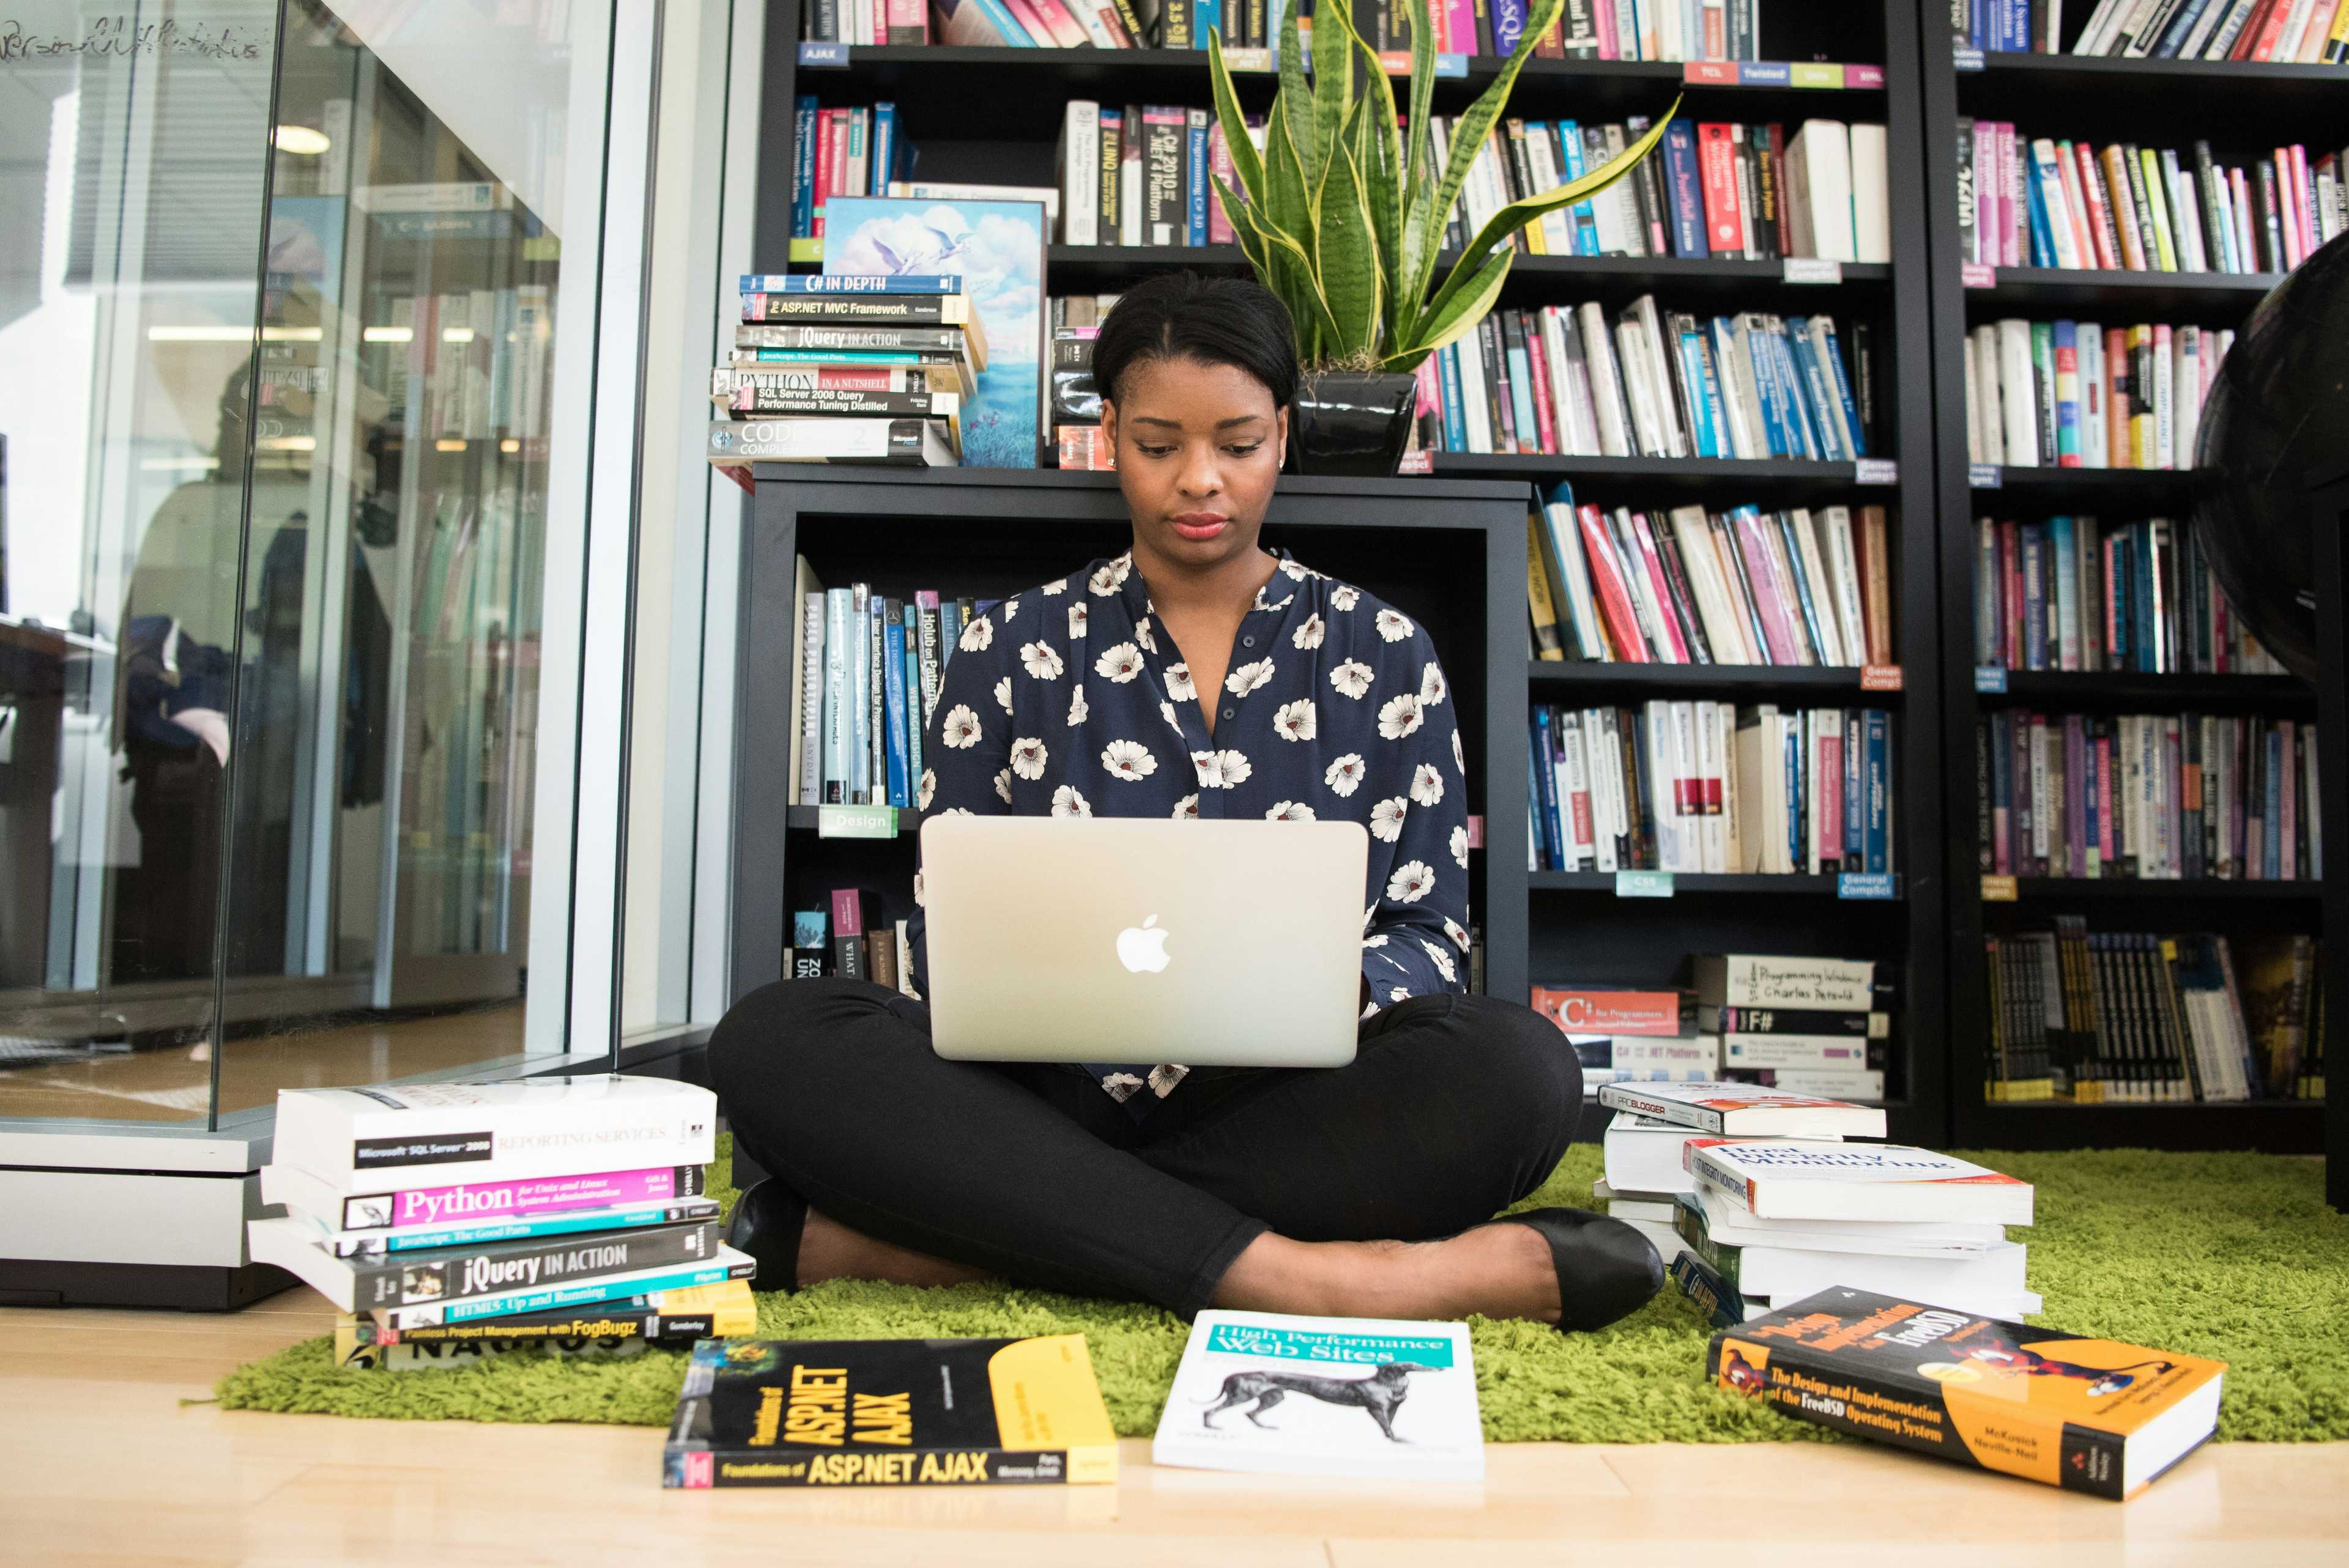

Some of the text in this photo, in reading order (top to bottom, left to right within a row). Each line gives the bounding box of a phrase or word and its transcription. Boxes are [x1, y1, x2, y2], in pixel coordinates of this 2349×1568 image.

[806, 49, 837, 59] AJAX
[1743, 68, 1786, 79] Twisted
[1103, 141, 1118, 171] LINQ
[1193, 133, 1204, 196] Programming
[1711, 141, 1721, 188] Windows
[1150, 135, 1163, 221] .NET 4 Platform
[1162, 155, 1178, 190] 2010
[1722, 141, 1736, 211] Programming
[806, 275, 886, 292] C# IN DEPTH
[781, 302, 823, 314] ASP.NET
[825, 303, 848, 314] MVC
[850, 303, 907, 315] Framework
[797, 325, 901, 347] jQuery IN ACTION
[740, 374, 815, 390] PYTHON
[822, 379, 887, 389] IN A NUTSHELL
[758, 399, 888, 412] Performance Tuning Distilled
[759, 388, 864, 402] SQL Server 2008 Query
[873, 618, 881, 635] User
[874, 637, 882, 668] Interface
[891, 649, 900, 679] DESIGN
[923, 615, 937, 706] Holub on Patterns
[806, 605, 818, 738] PAPER PROTOTYPING
[874, 668, 882, 694] Design
[872, 707, 881, 755] Programmers
[910, 686, 920, 768] WEB PAGE DESIGN
[836, 814, 886, 829] Design
[1841, 885, 1890, 896] CompSci
[1844, 874, 1888, 884] General
[845, 942, 855, 975] WHAT
[1760, 966, 1822, 986] Programming
[1764, 987, 1811, 1000] Charles
[1610, 1008, 1664, 1019] Programmers
[1749, 1011, 1773, 1032] F#
[1666, 1046, 1701, 1059] Platform
[358, 1140, 491, 1159] Microsoft SQL Server 2008
[498, 1126, 667, 1151] REPORTING SERVICES
[1716, 1146, 1802, 1155] Host
[1726, 1152, 1884, 1163] Integrity
[1737, 1157, 1956, 1170] Monitoring
[518, 1178, 608, 1197] for Unix and Linux
[1701, 1159, 1746, 1200] INTEGRITY MONITORING
[403, 1185, 514, 1224] Python
[516, 1188, 621, 1208] System Administration
[455, 1229, 473, 1240] The
[475, 1226, 503, 1239] Good
[505, 1224, 531, 1235] Parts
[461, 1244, 628, 1295] jQuery IN ACTION
[506, 1295, 526, 1311] Up
[527, 1292, 552, 1308] and
[554, 1285, 607, 1304] Running
[404, 1329, 447, 1339] Painless
[448, 1327, 483, 1339] Project
[484, 1325, 548, 1338] Management
[548, 1323, 571, 1335] with
[571, 1319, 637, 1338] FogBugz
[1218, 1325, 1444, 1350] High Performance
[1873, 1310, 1970, 1348] FreeBSD
[1215, 1336, 1395, 1363] Web Sites
[782, 1364, 848, 1446] ASP.NET
[1771, 1366, 1943, 1424] The Design and Implementation
[851, 1392, 913, 1446] AJAX
[1770, 1387, 1943, 1443] of the FreeBSD Operating System
[1974, 1437, 2038, 1462] Neville-Neil
[721, 1452, 989, 1484] Foundations of ASP.NET AJAX
